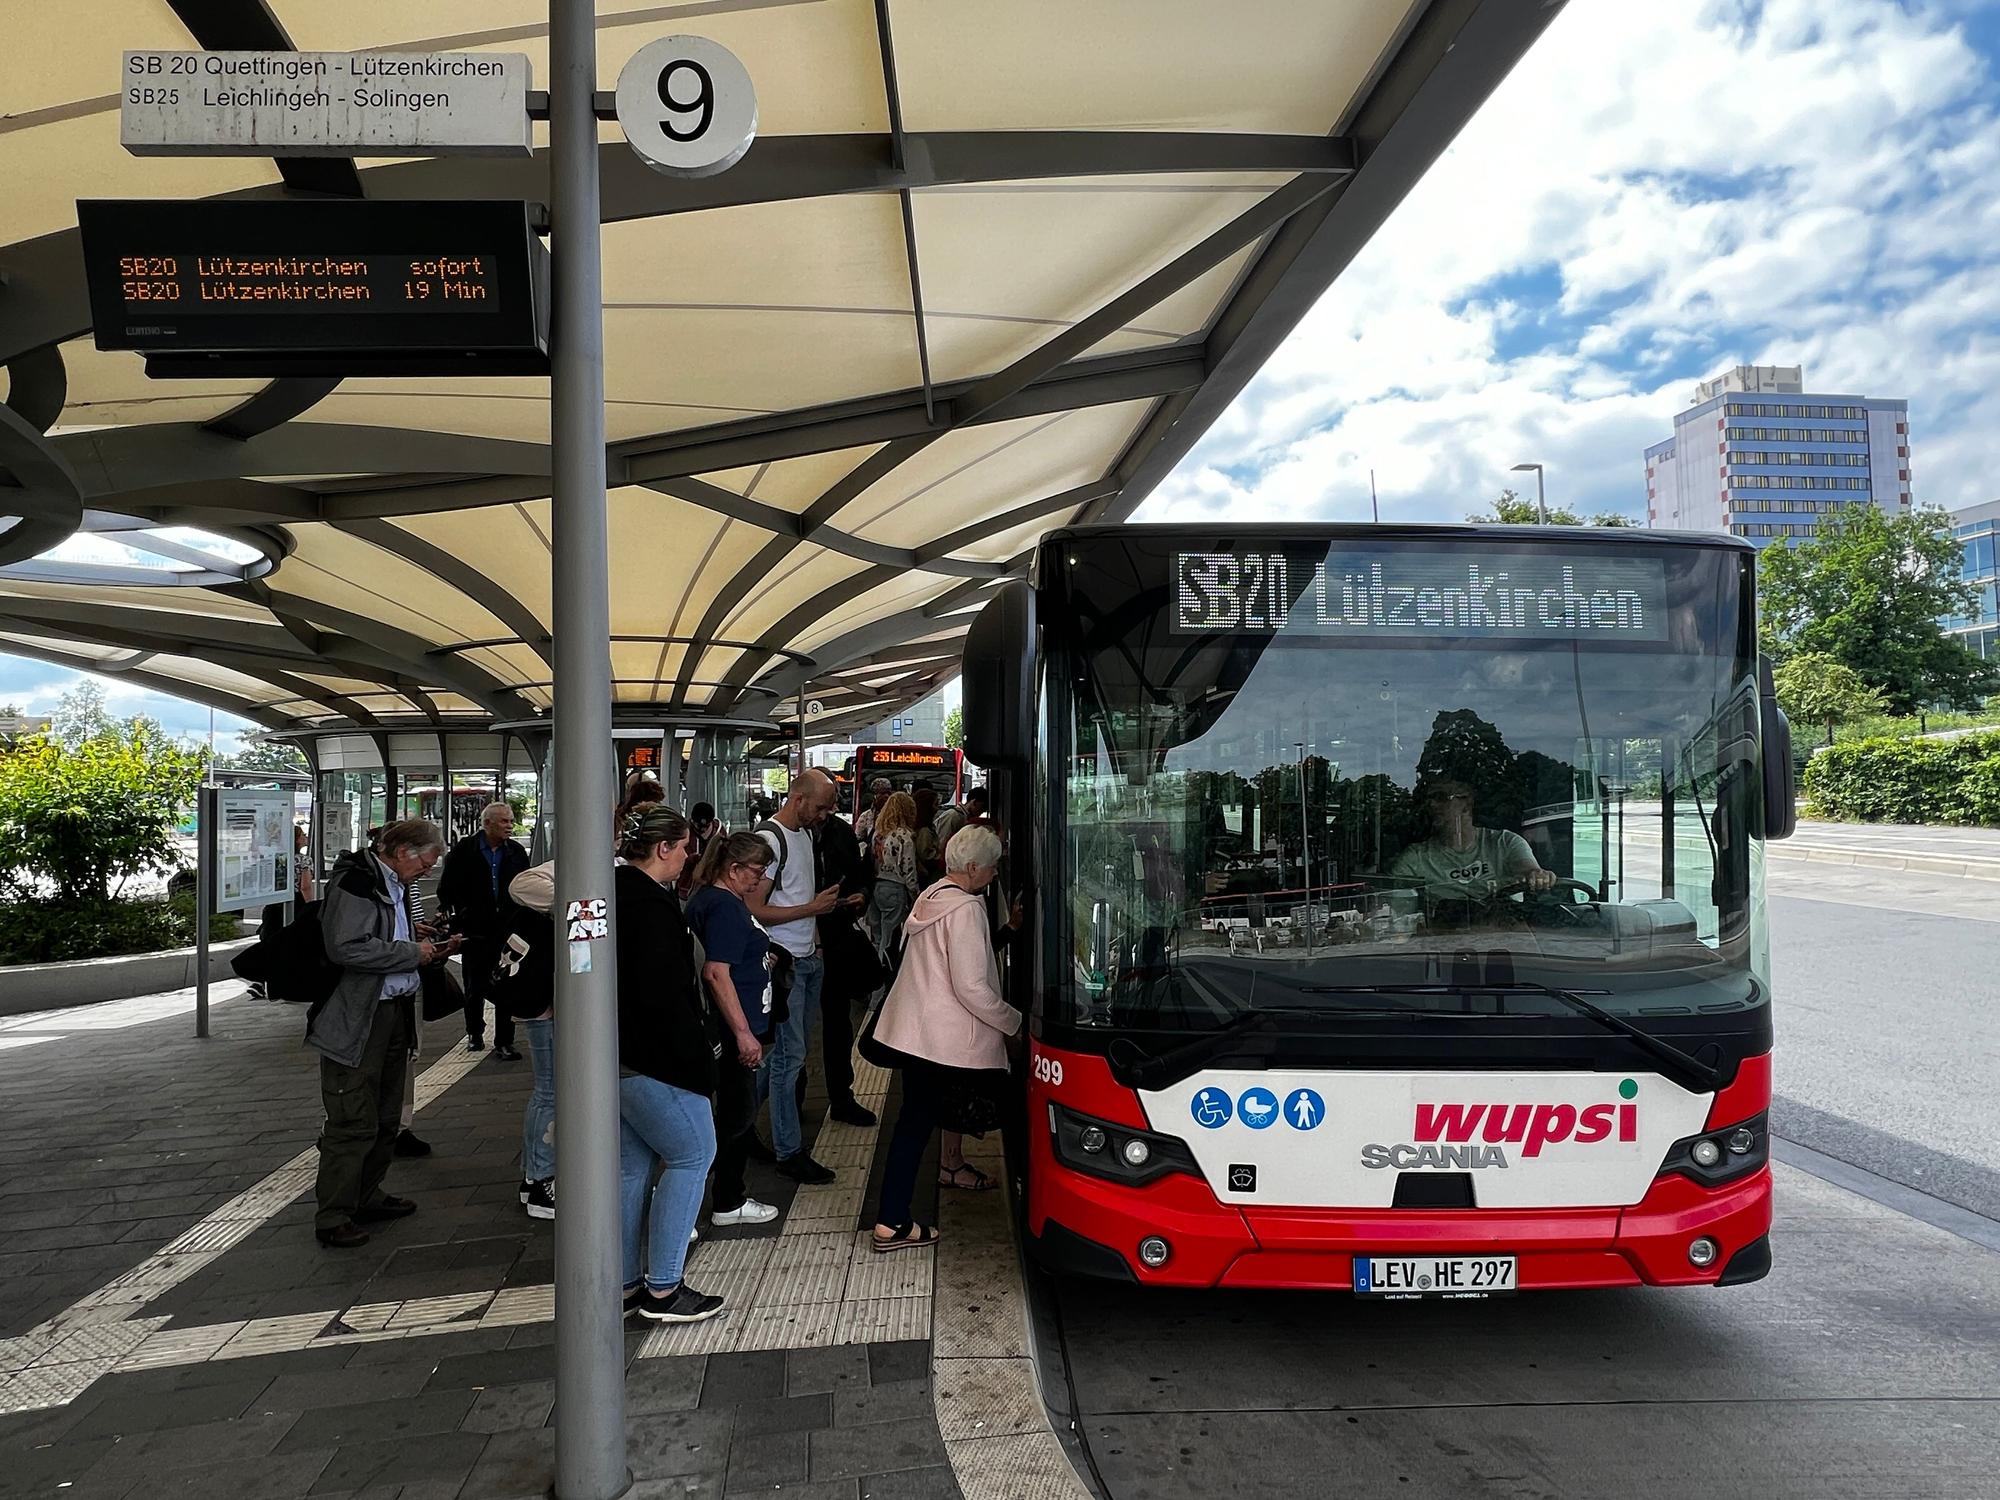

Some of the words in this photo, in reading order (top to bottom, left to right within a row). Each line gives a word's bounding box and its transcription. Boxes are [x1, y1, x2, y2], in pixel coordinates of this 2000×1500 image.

[129, 56, 162, 75] SB
[170, 56, 198, 75] 20
[204, 56, 326, 80] Quettingen
[350, 57, 505, 77] Lützenkirchen
[129, 88, 179, 105] SB25
[203, 88, 330, 111] Leichlingen
[353, 88, 449, 112] Solingen
[657, 59, 715, 143] 9
[119, 257, 178, 277] SB20
[197, 257, 368, 277] Lützenkirchen
[409, 257, 484, 280] sofort
[122, 281, 180, 300] SB20
[200, 281, 370, 300] Lützenkirchen
[404, 281, 430, 299] 19
[443, 281, 486, 299] Min
[1178, 552, 1289, 629] SB20
[1315, 562, 1644, 629] Lützenkirchen
[810, 702, 819, 715] 8
[1034, 1054, 1063, 1086] 299
[1413, 1078, 1639, 1158] wupsi
[1360, 1144, 1509, 1169] SCANIA
[1371, 1262, 1416, 1288] LEV
[1435, 1261, 1464, 1287] HE
[1471, 1260, 1513, 1286] 297
